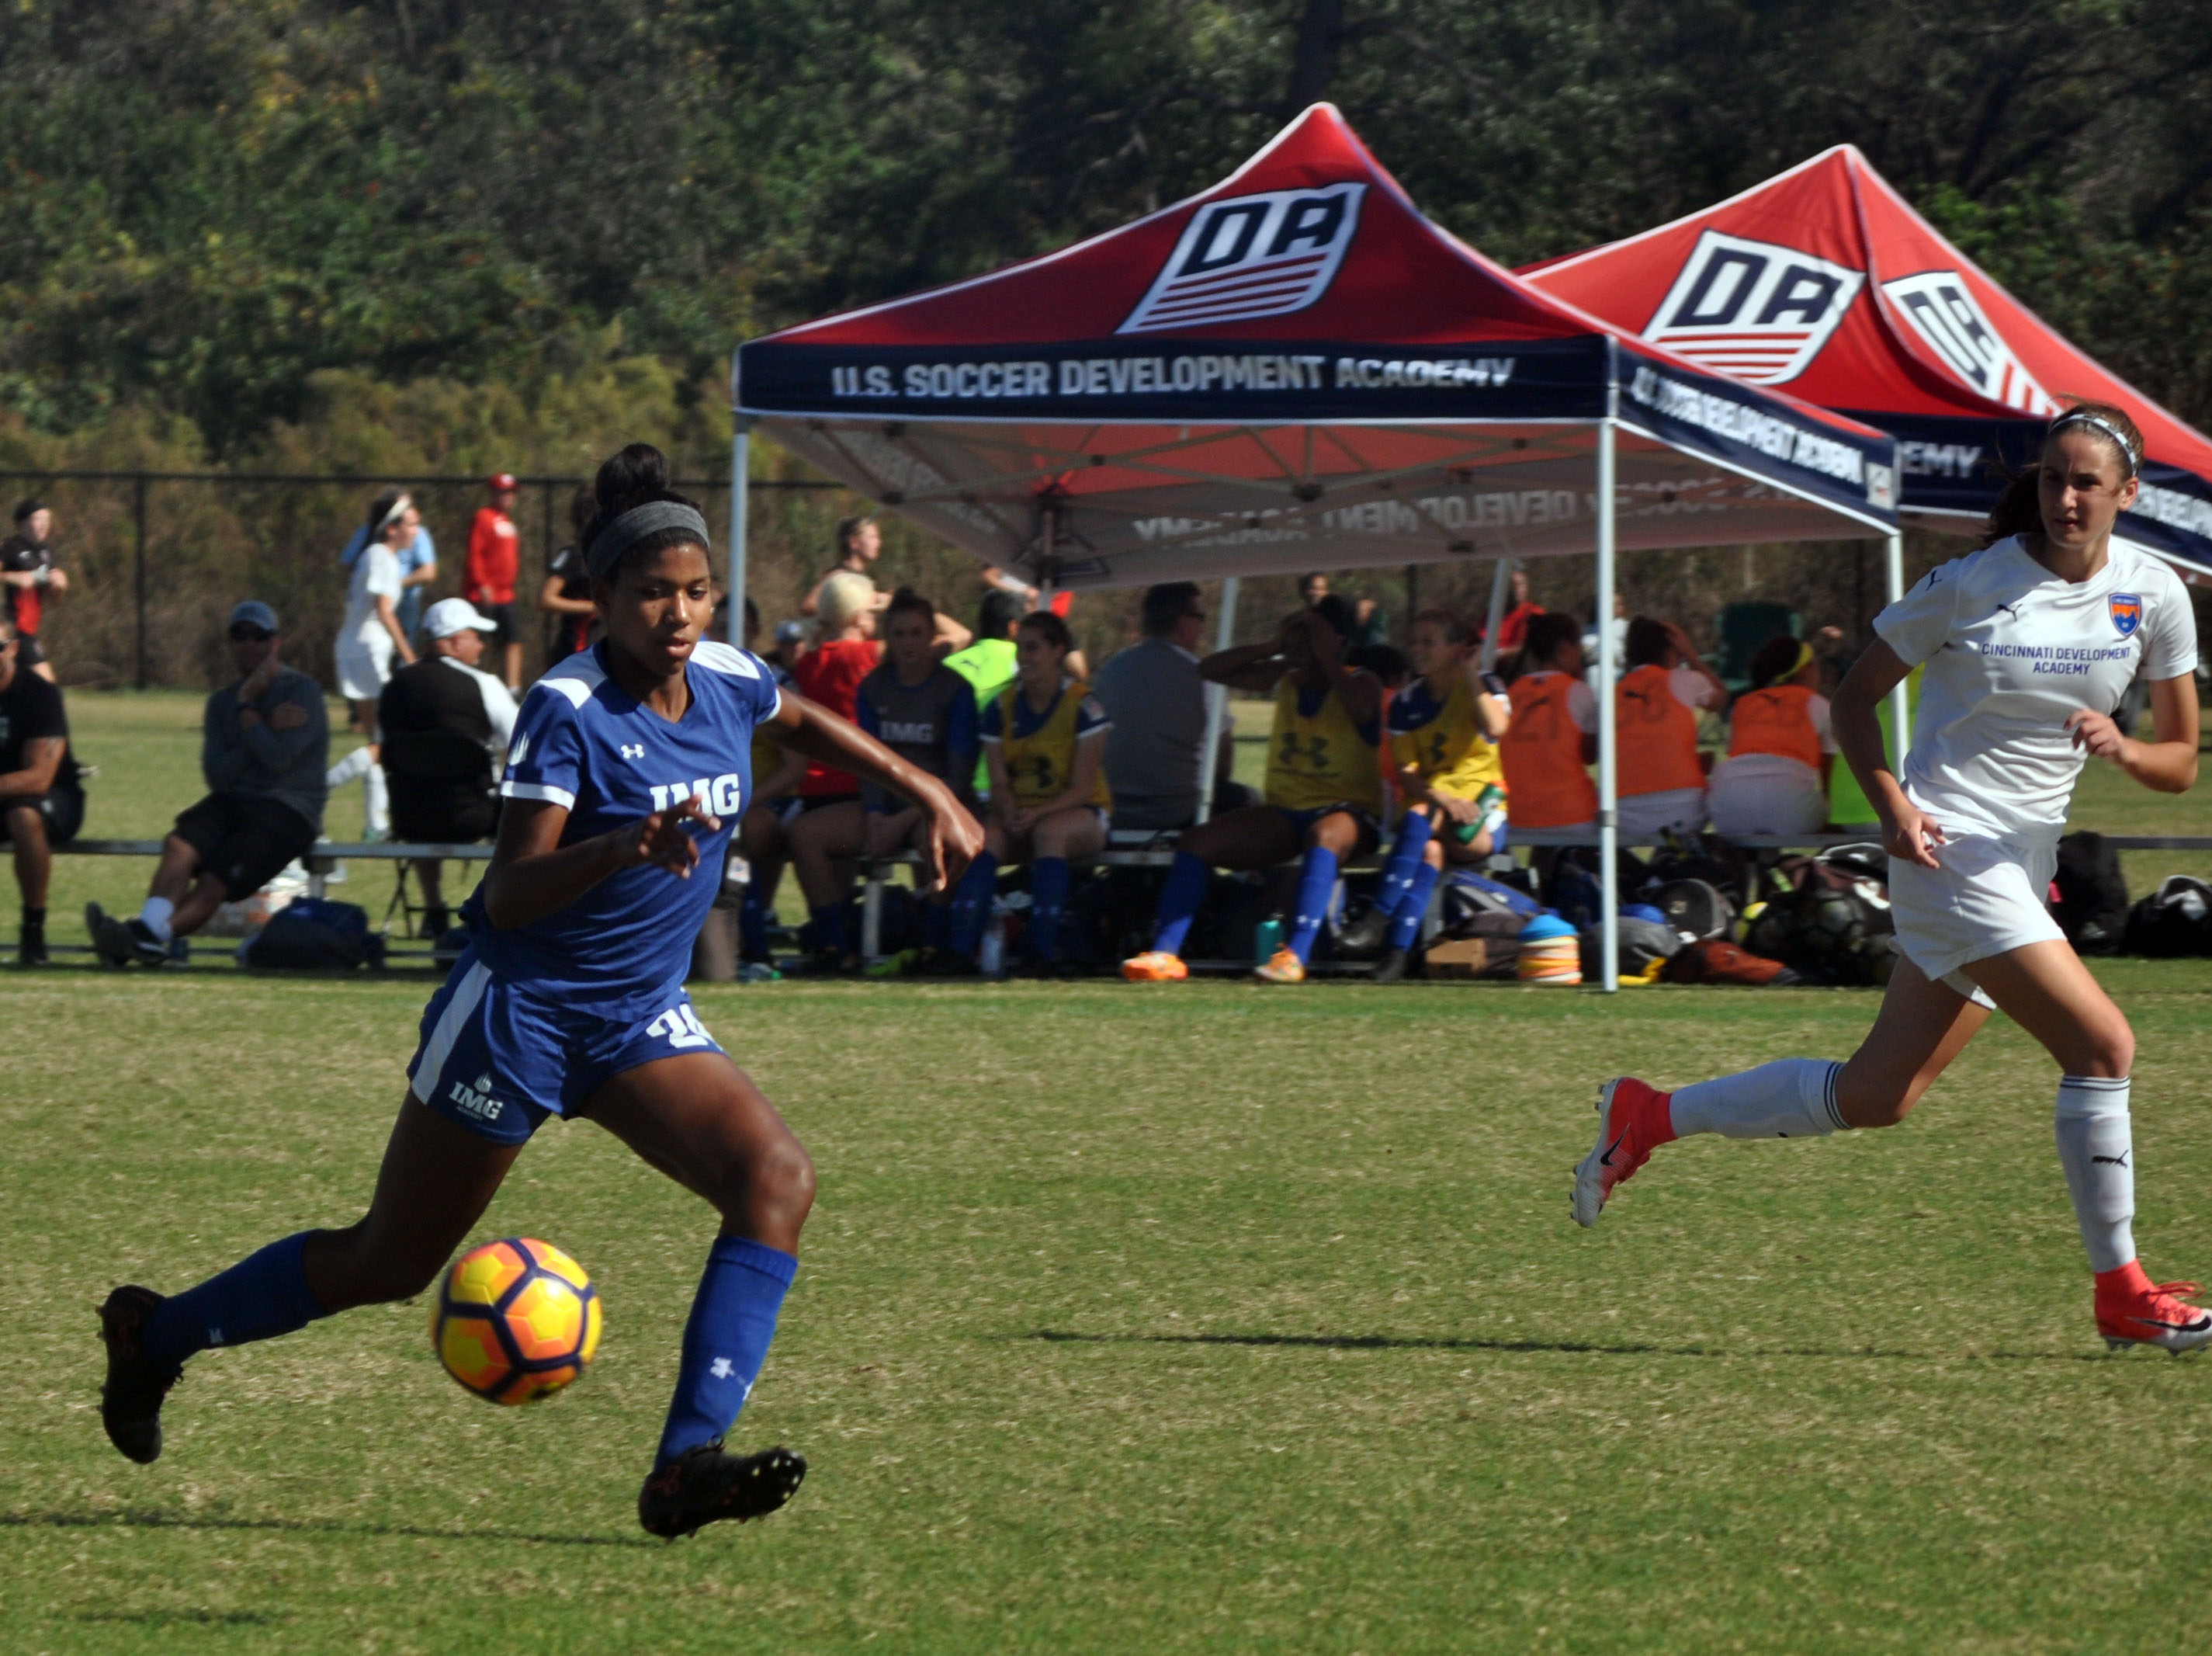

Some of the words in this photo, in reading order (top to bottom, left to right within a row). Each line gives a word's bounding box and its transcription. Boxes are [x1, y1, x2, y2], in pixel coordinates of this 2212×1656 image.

[1174, 191, 1350, 278] DA
[1666, 245, 1845, 328] DA
[831, 365, 899, 397] U.S.
[903, 360, 1050, 398] SOCCER
[1058, 355, 1326, 396] DEVELOPMENT
[1336, 356, 1516, 389] ACADEMY
[1981, 643, 2053, 659] CINCINNATI
[2056, 647, 2131, 661] DEVELOPMENT
[2033, 661, 2090, 675] ACADEMY
[448, 1081, 504, 1120] IMG
